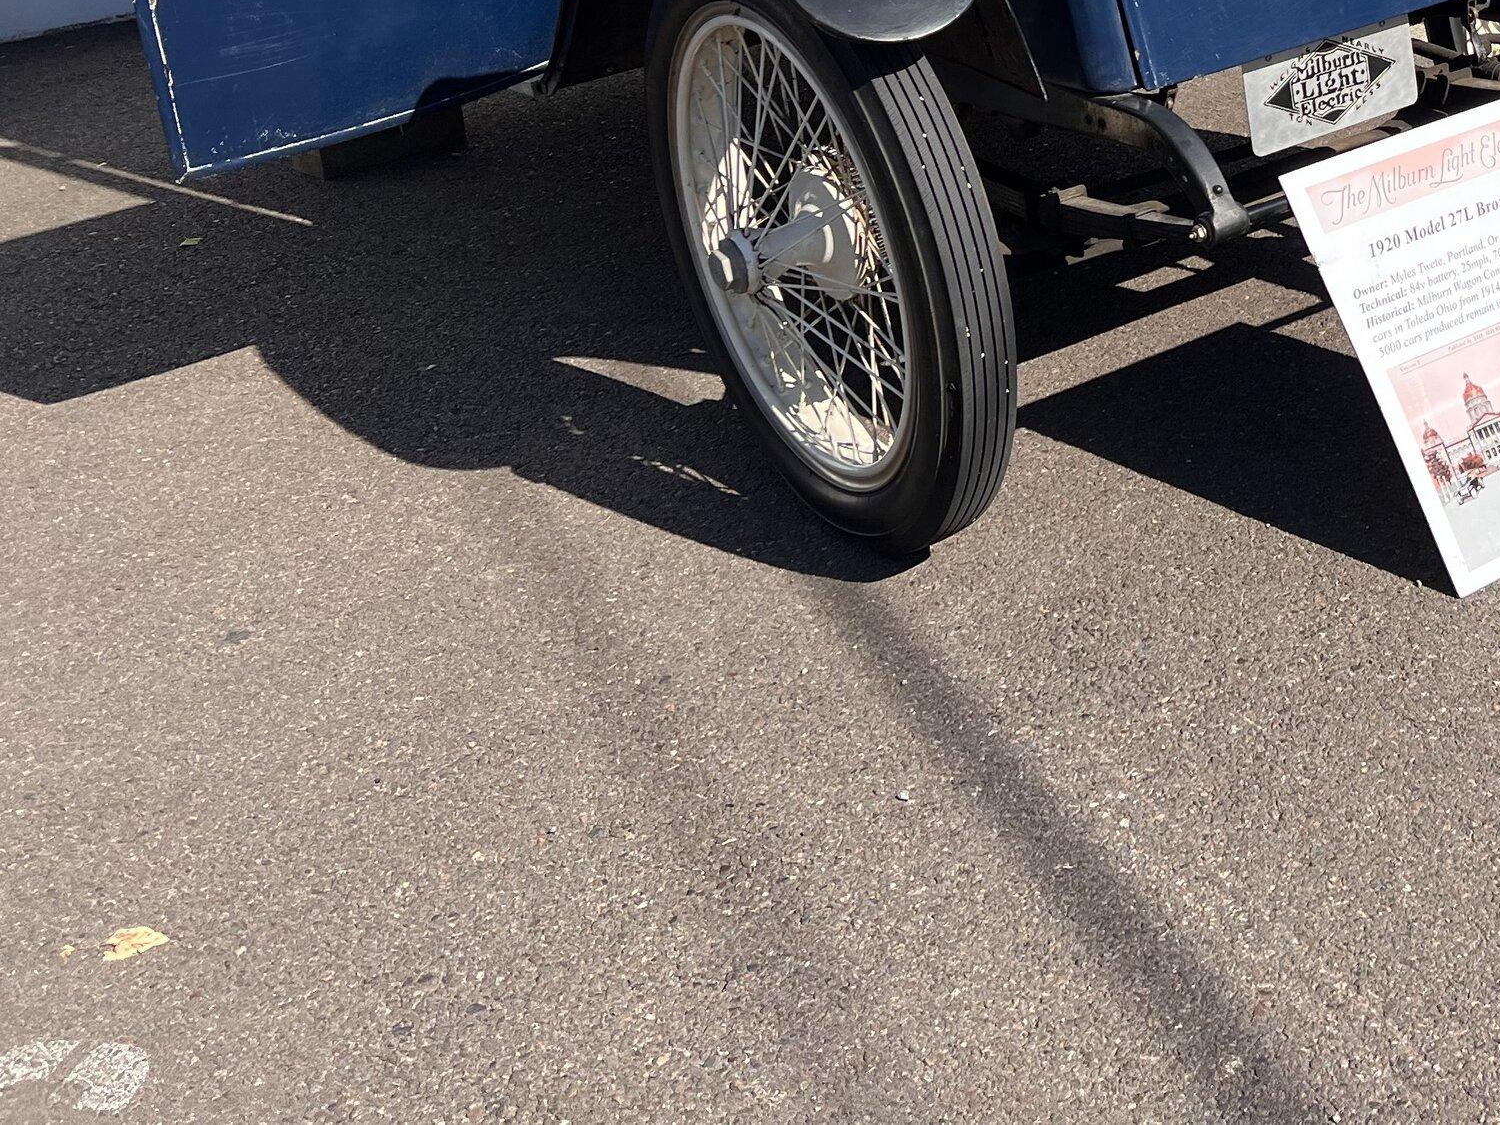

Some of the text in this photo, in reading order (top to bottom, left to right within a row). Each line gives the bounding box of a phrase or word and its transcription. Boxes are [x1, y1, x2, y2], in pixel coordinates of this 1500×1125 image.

[1291, 51, 1366, 84] Milburn
[1300, 88, 1364, 117] Electric
[1321, 184, 1365, 225] The
[1362, 164, 1435, 215] Milburn
[1429, 142, 1475, 188] Light
[1368, 233, 1401, 259] 1920
[1404, 216, 1447, 245] Model
[1449, 207, 1474, 227] 27L
[1353, 279, 1388, 299] Owner:
[1390, 268, 1416, 286] Myles
[1487, 234, 1499, 246] Or
[1359, 287, 1407, 314] Technical:
[1409, 281, 1425, 294] 84v
[1366, 301, 1415, 329] Historical:
[1417, 287, 1452, 308] Milburn
[1453, 275, 1482, 291] Wagon
[1373, 331, 1392, 344] cars
[1395, 321, 1403, 334] in
[1404, 310, 1434, 330] Toledo
[1436, 302, 1458, 316] Ohio
[1458, 292, 1481, 310] from
[1481, 282, 1500, 298] 1914
[1379, 339, 1401, 358] 5000
[1403, 334, 1423, 347] cars
[1425, 312, 1464, 341] produced
[1466, 304, 1495, 321] remain
